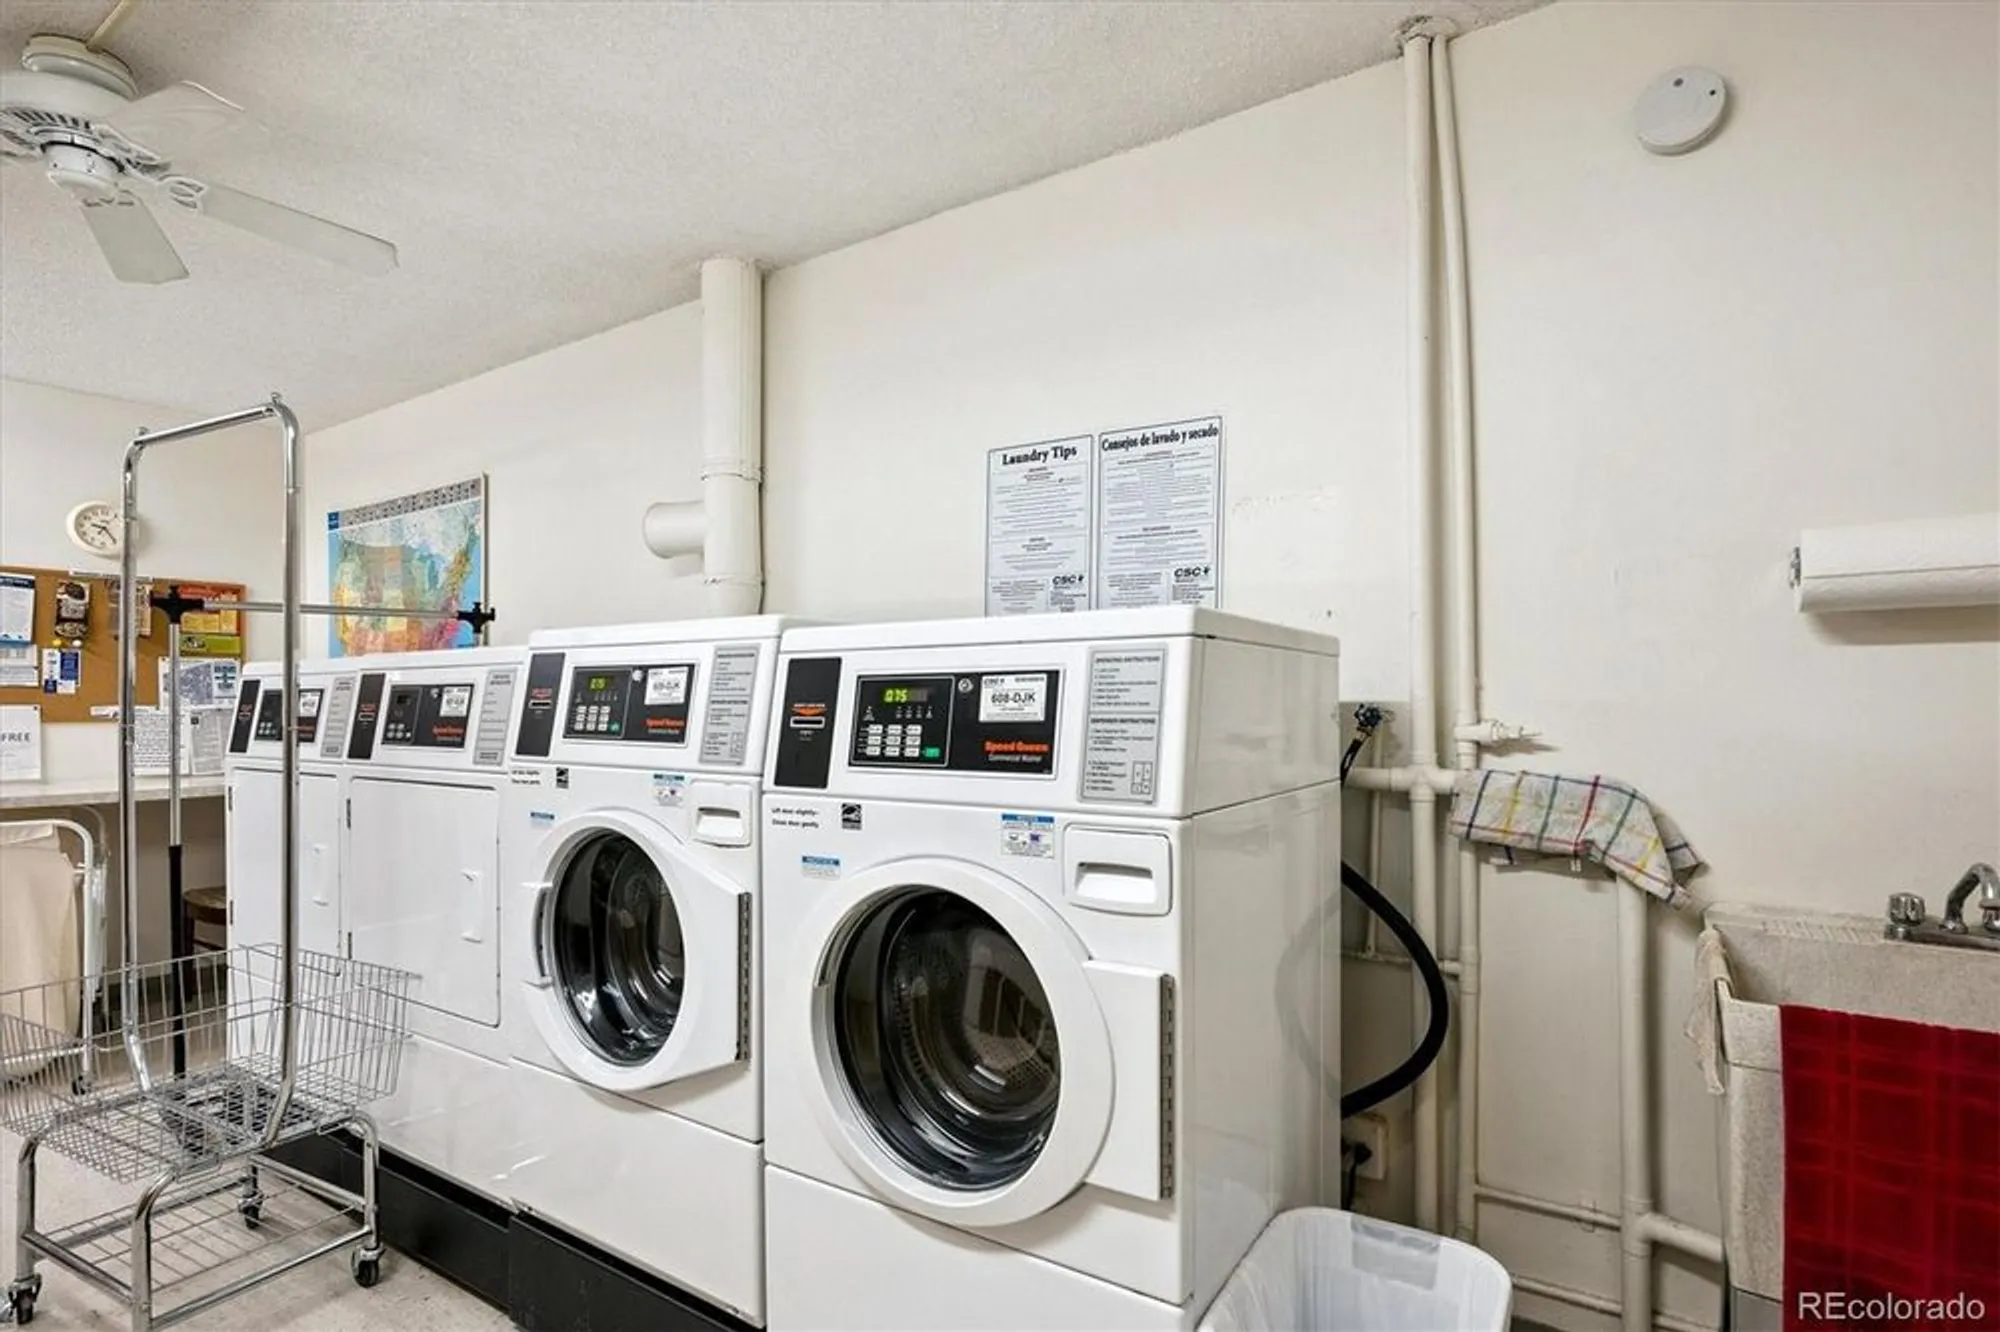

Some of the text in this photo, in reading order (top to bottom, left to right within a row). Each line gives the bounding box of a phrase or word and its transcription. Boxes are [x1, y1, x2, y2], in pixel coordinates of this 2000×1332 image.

[1102, 423, 1219, 452] Consejos de lavado y secado
[1002, 446, 1078, 465] Laundry Tips
[1174, 566, 1201, 578] CSC
[1052, 575, 1076, 585] CSC
